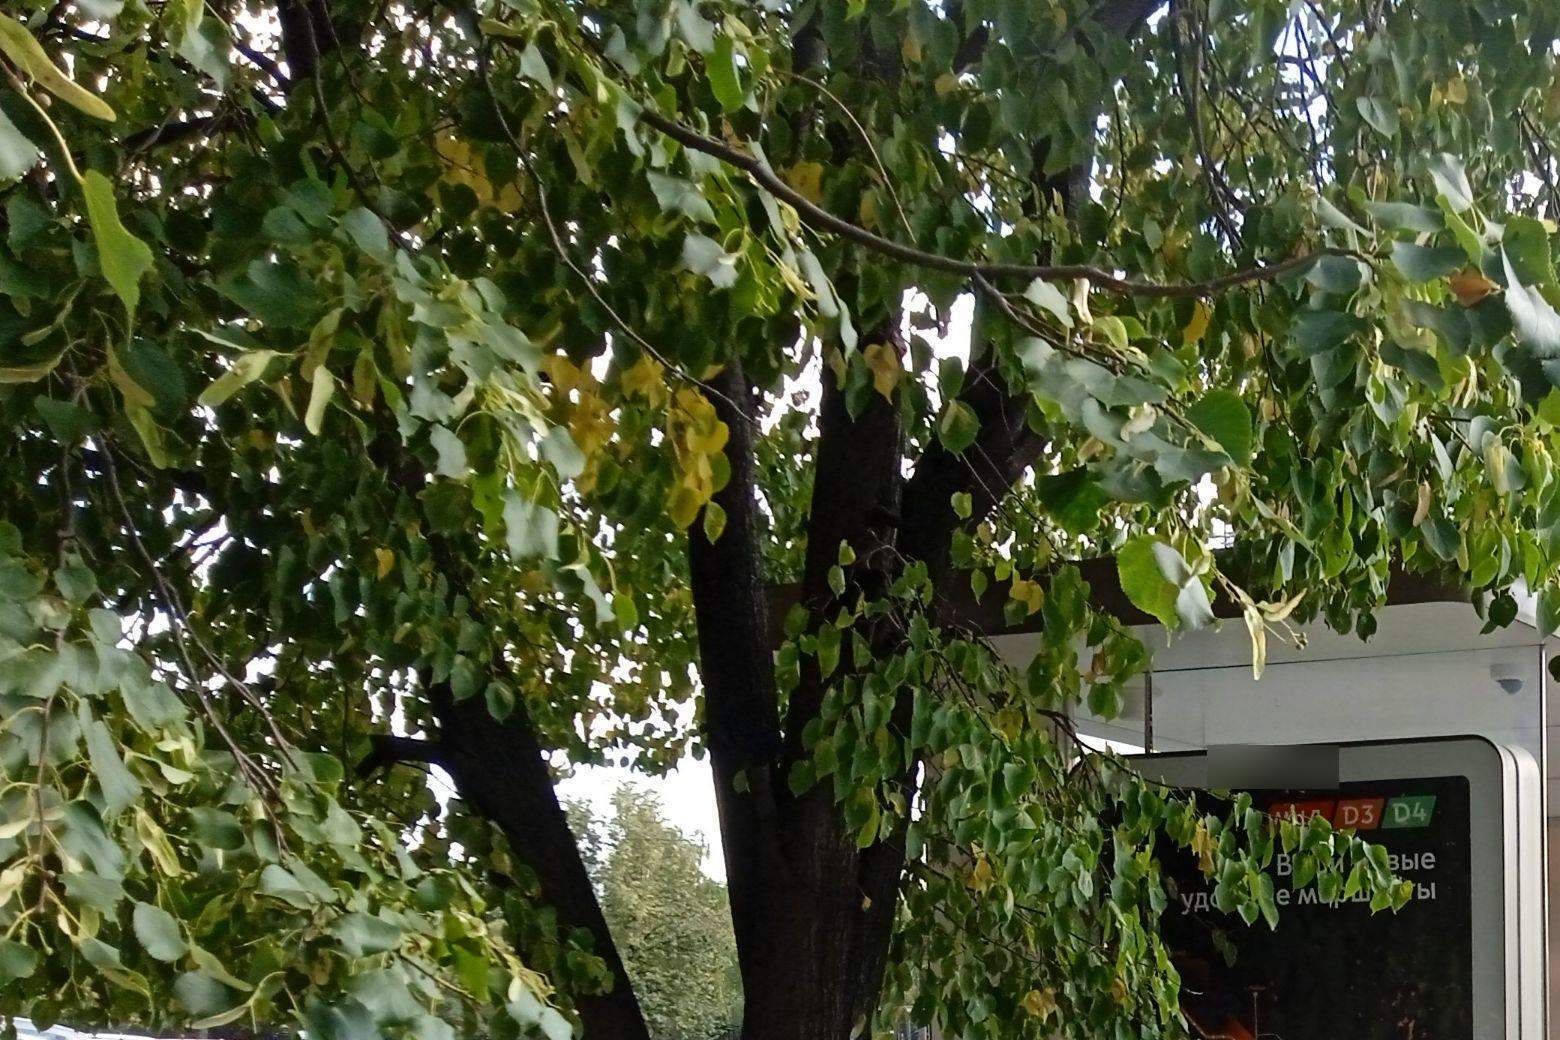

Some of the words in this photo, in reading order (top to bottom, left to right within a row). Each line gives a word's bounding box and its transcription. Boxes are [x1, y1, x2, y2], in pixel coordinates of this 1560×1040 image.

[1342, 804, 1375, 825] D3
[1392, 802, 1427, 822] D4
[1277, 853, 1344, 876] Ви
